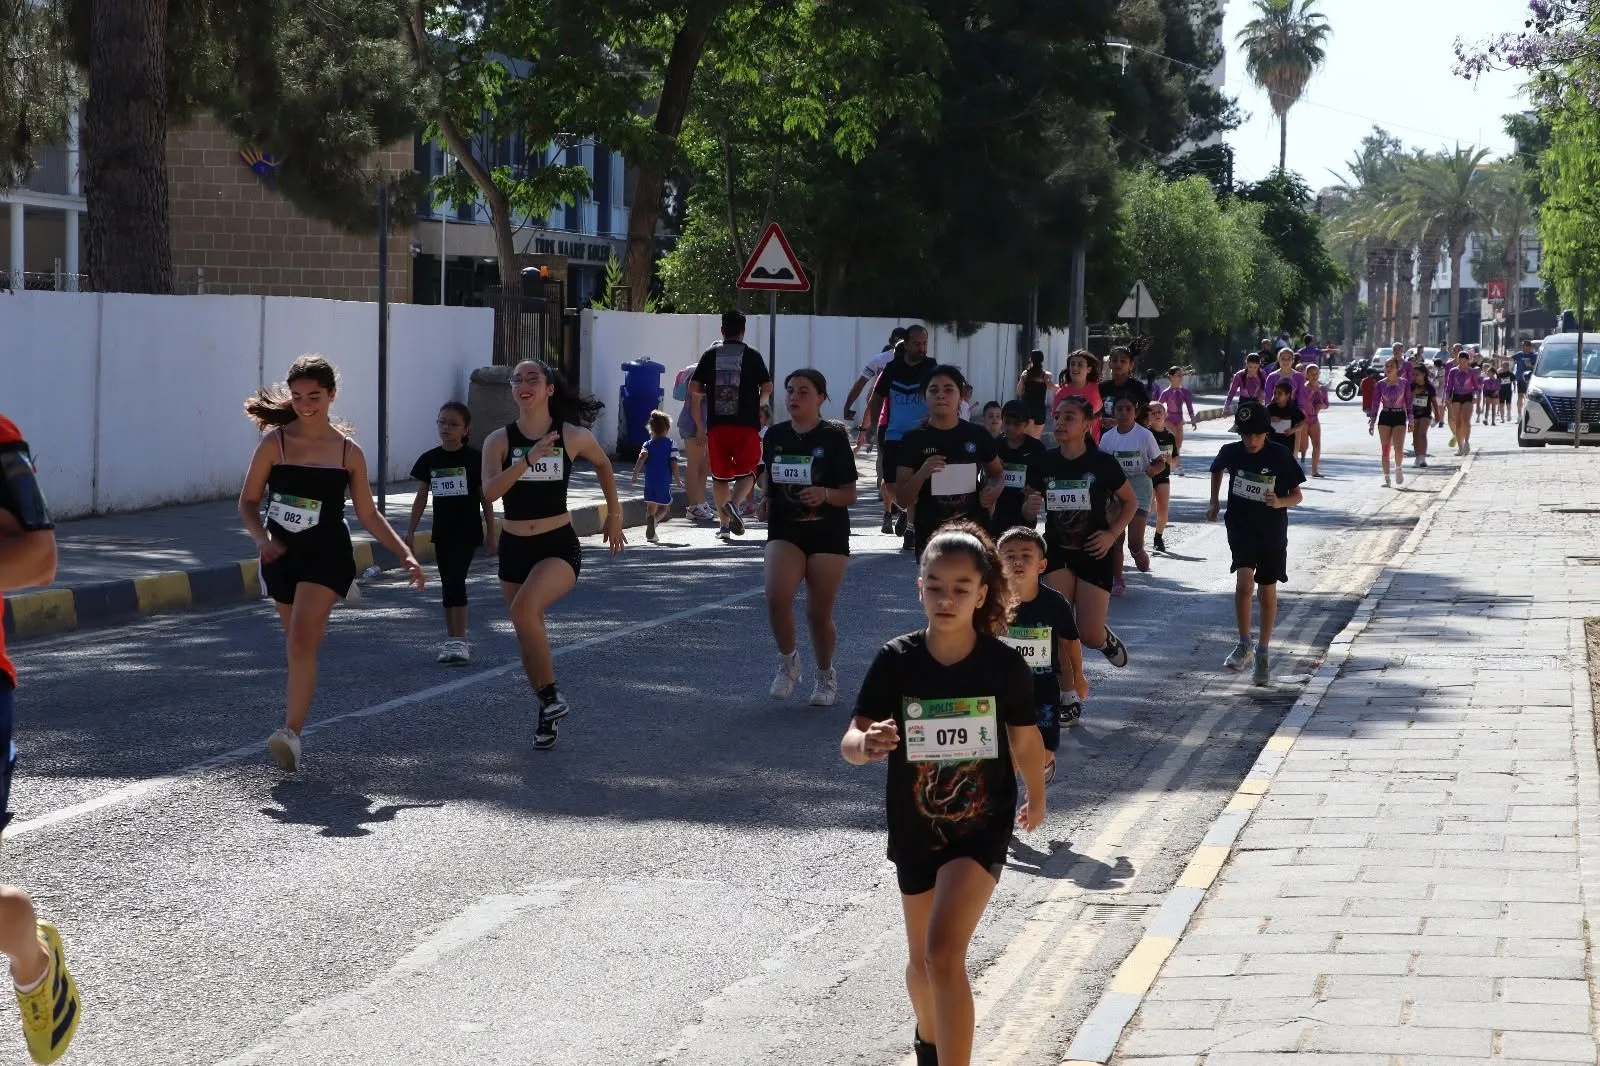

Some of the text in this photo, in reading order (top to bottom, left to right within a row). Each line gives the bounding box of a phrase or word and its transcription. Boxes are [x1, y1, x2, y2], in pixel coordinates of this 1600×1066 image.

[784, 468, 798, 477] 073
[441, 481, 454, 490] 105
[1246, 484, 1260, 494] 020
[1060, 495, 1076, 503] 078
[284, 511, 302, 524] 082
[936, 728, 967, 745] 079
